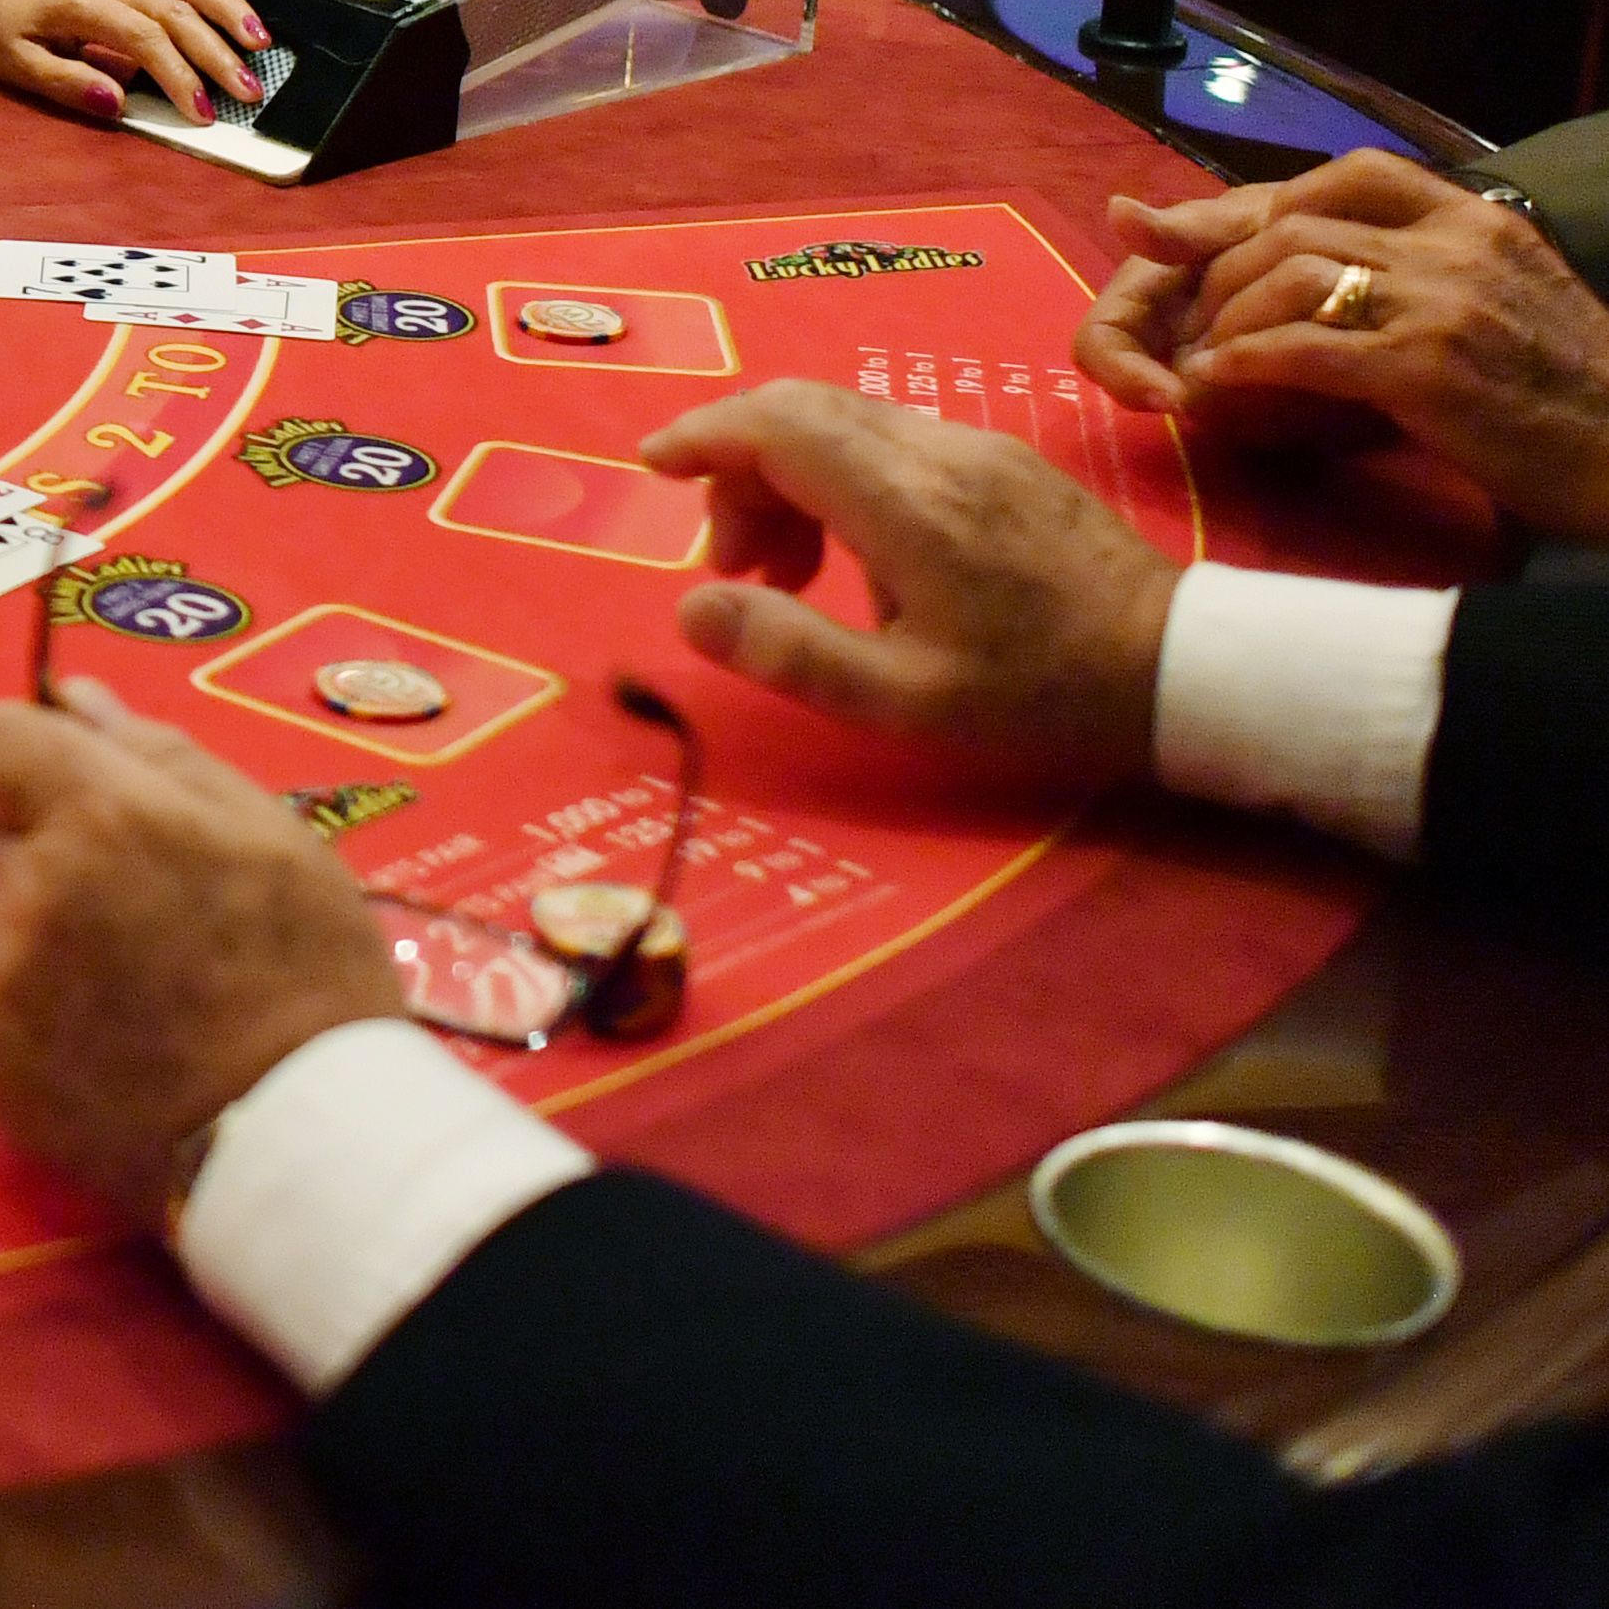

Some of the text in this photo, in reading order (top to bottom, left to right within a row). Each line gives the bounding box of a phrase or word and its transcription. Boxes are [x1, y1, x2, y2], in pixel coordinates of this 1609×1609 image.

[745, 250, 983, 281] Lucky Ladies
[393, 298, 449, 335] 20
[863, 356, 889, 369] to
[911, 361, 936, 373] to
[906, 373, 939, 396] 125
[951, 356, 985, 395] 19 to 1
[1007, 372, 1031, 385] to
[1053, 378, 1078, 391] to
[85, 342, 228, 460] 2 TO
[1001, 384, 1033, 395] 9
[1048, 390, 1080, 402] 4
[338, 445, 414, 486] 20
[135, 592, 232, 639] 20
